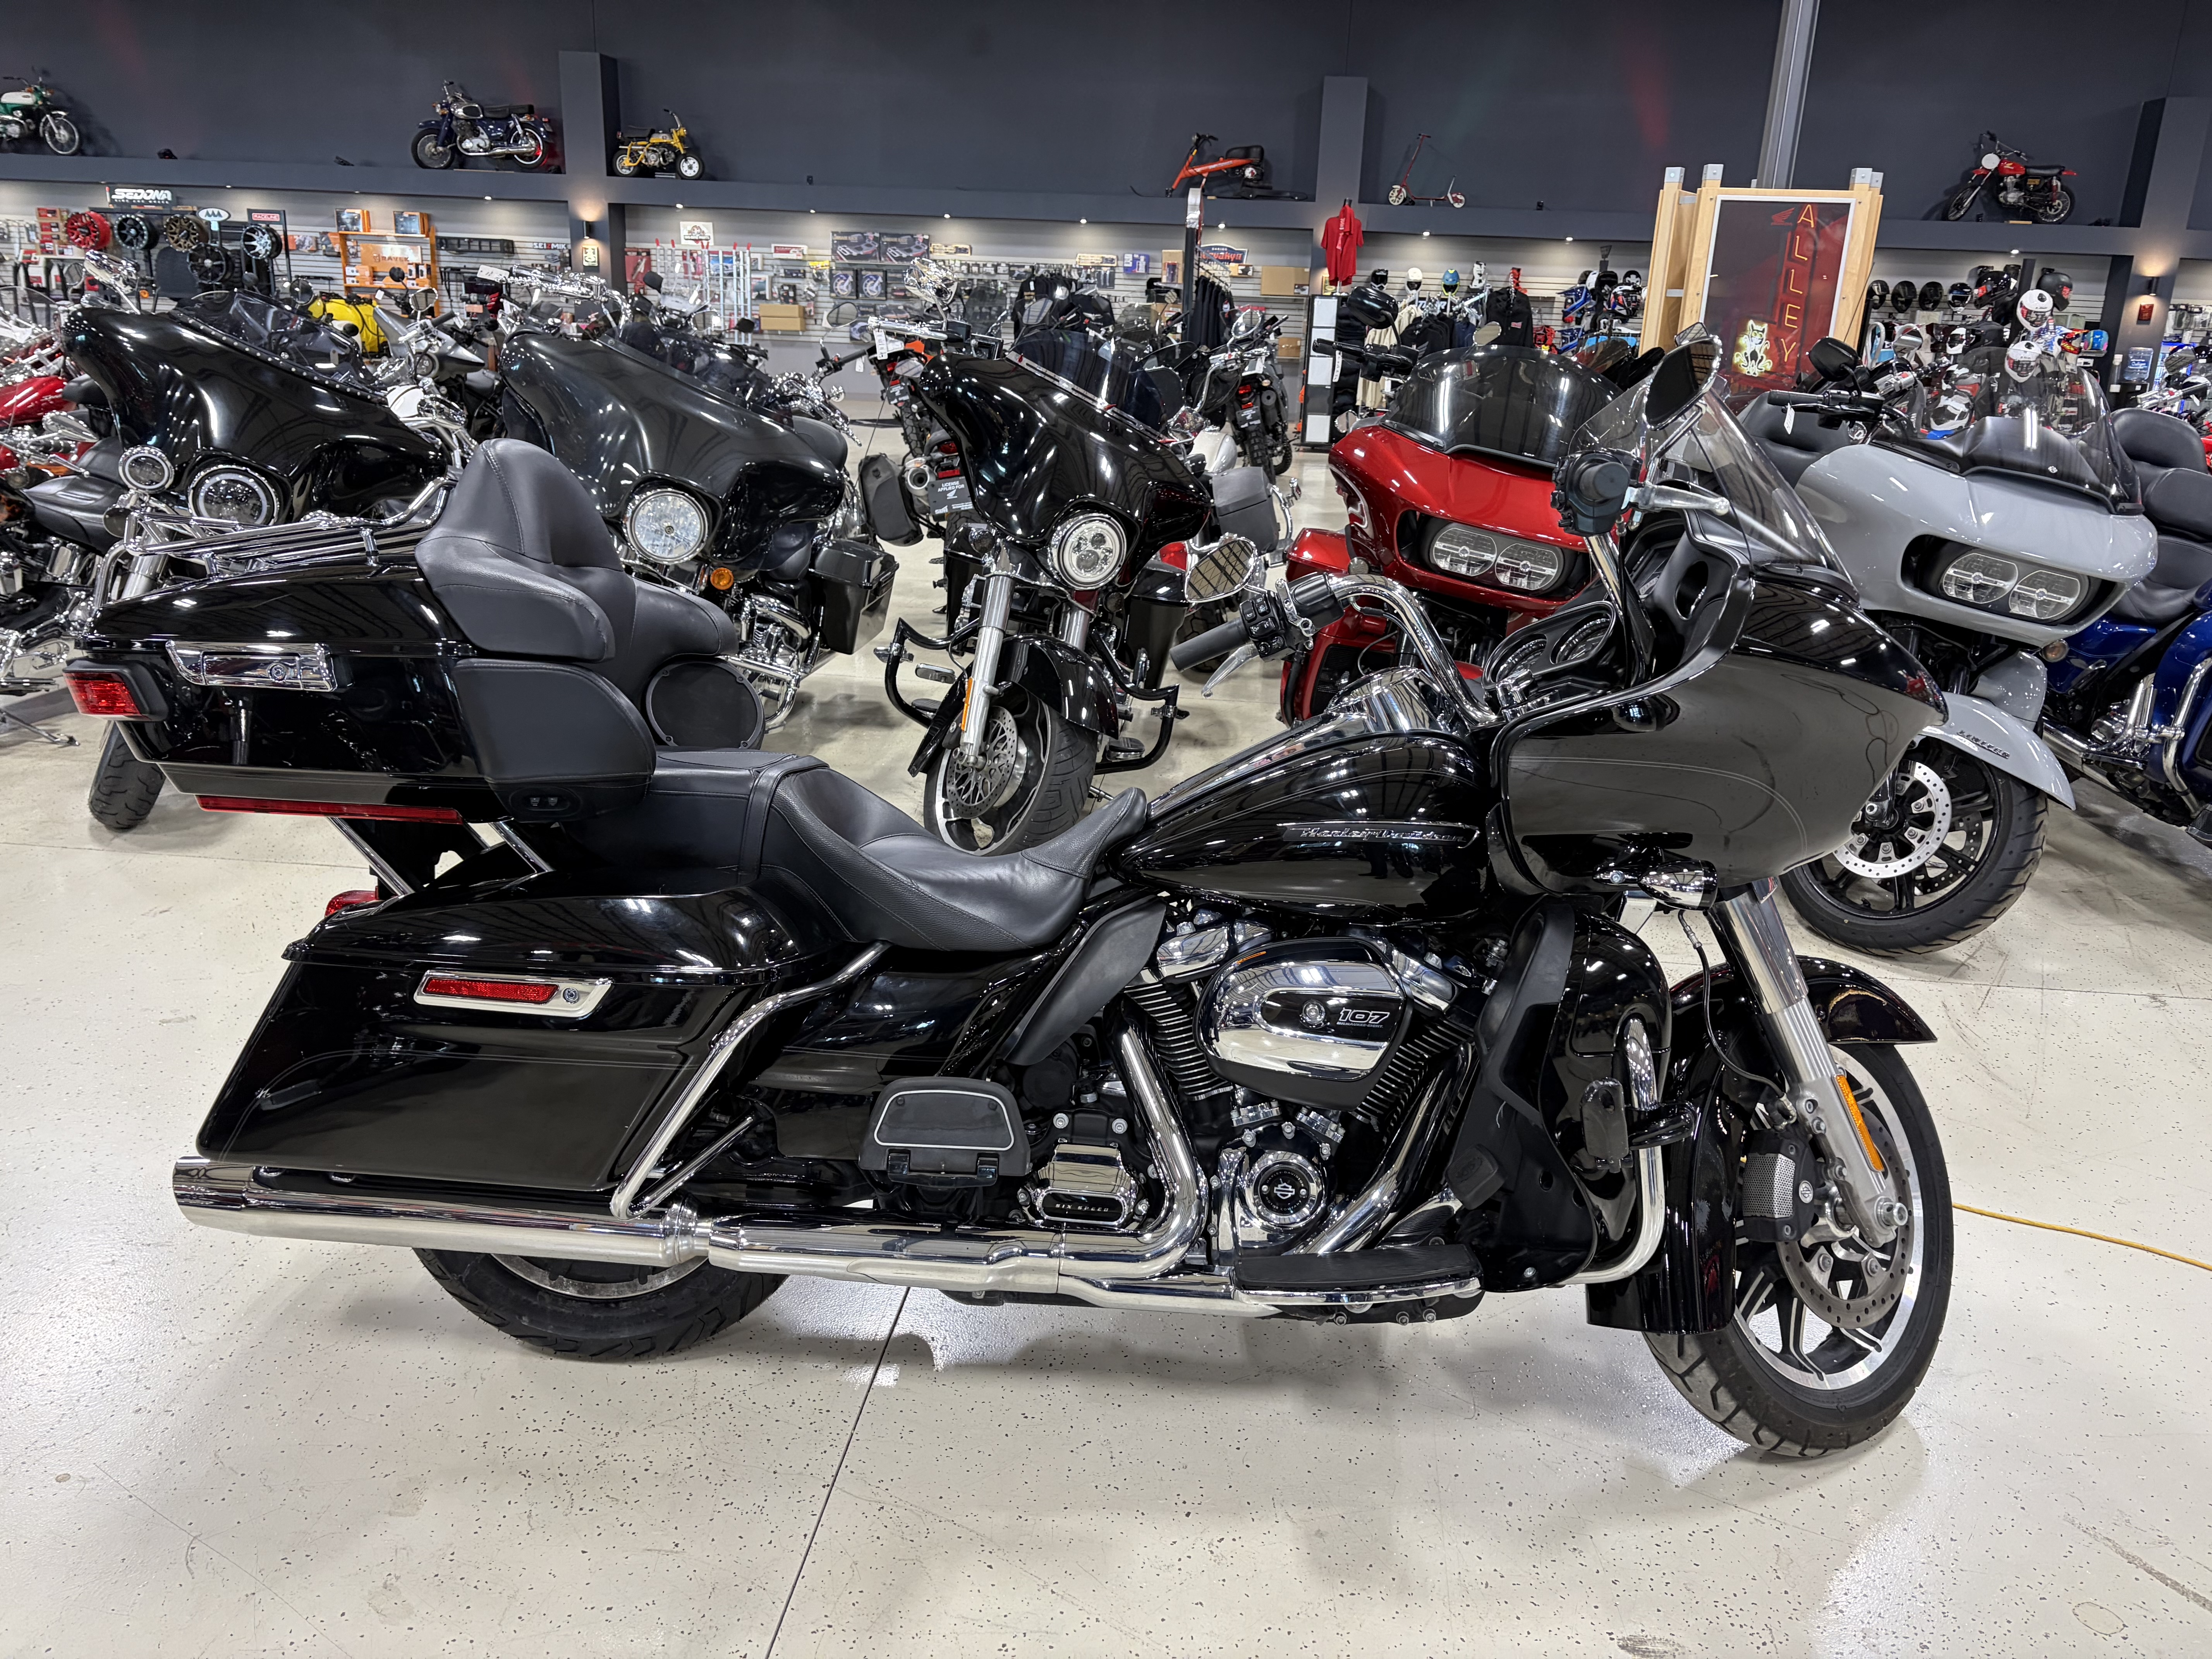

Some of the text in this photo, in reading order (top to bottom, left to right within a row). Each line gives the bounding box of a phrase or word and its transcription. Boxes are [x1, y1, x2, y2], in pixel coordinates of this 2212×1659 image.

[112, 189, 172, 200] SEDONA
[1781, 204, 1815, 362] ALLEY
[1339, 1009, 1390, 1024] 107
[1266, 1197, 1279, 1209] MOTOR
